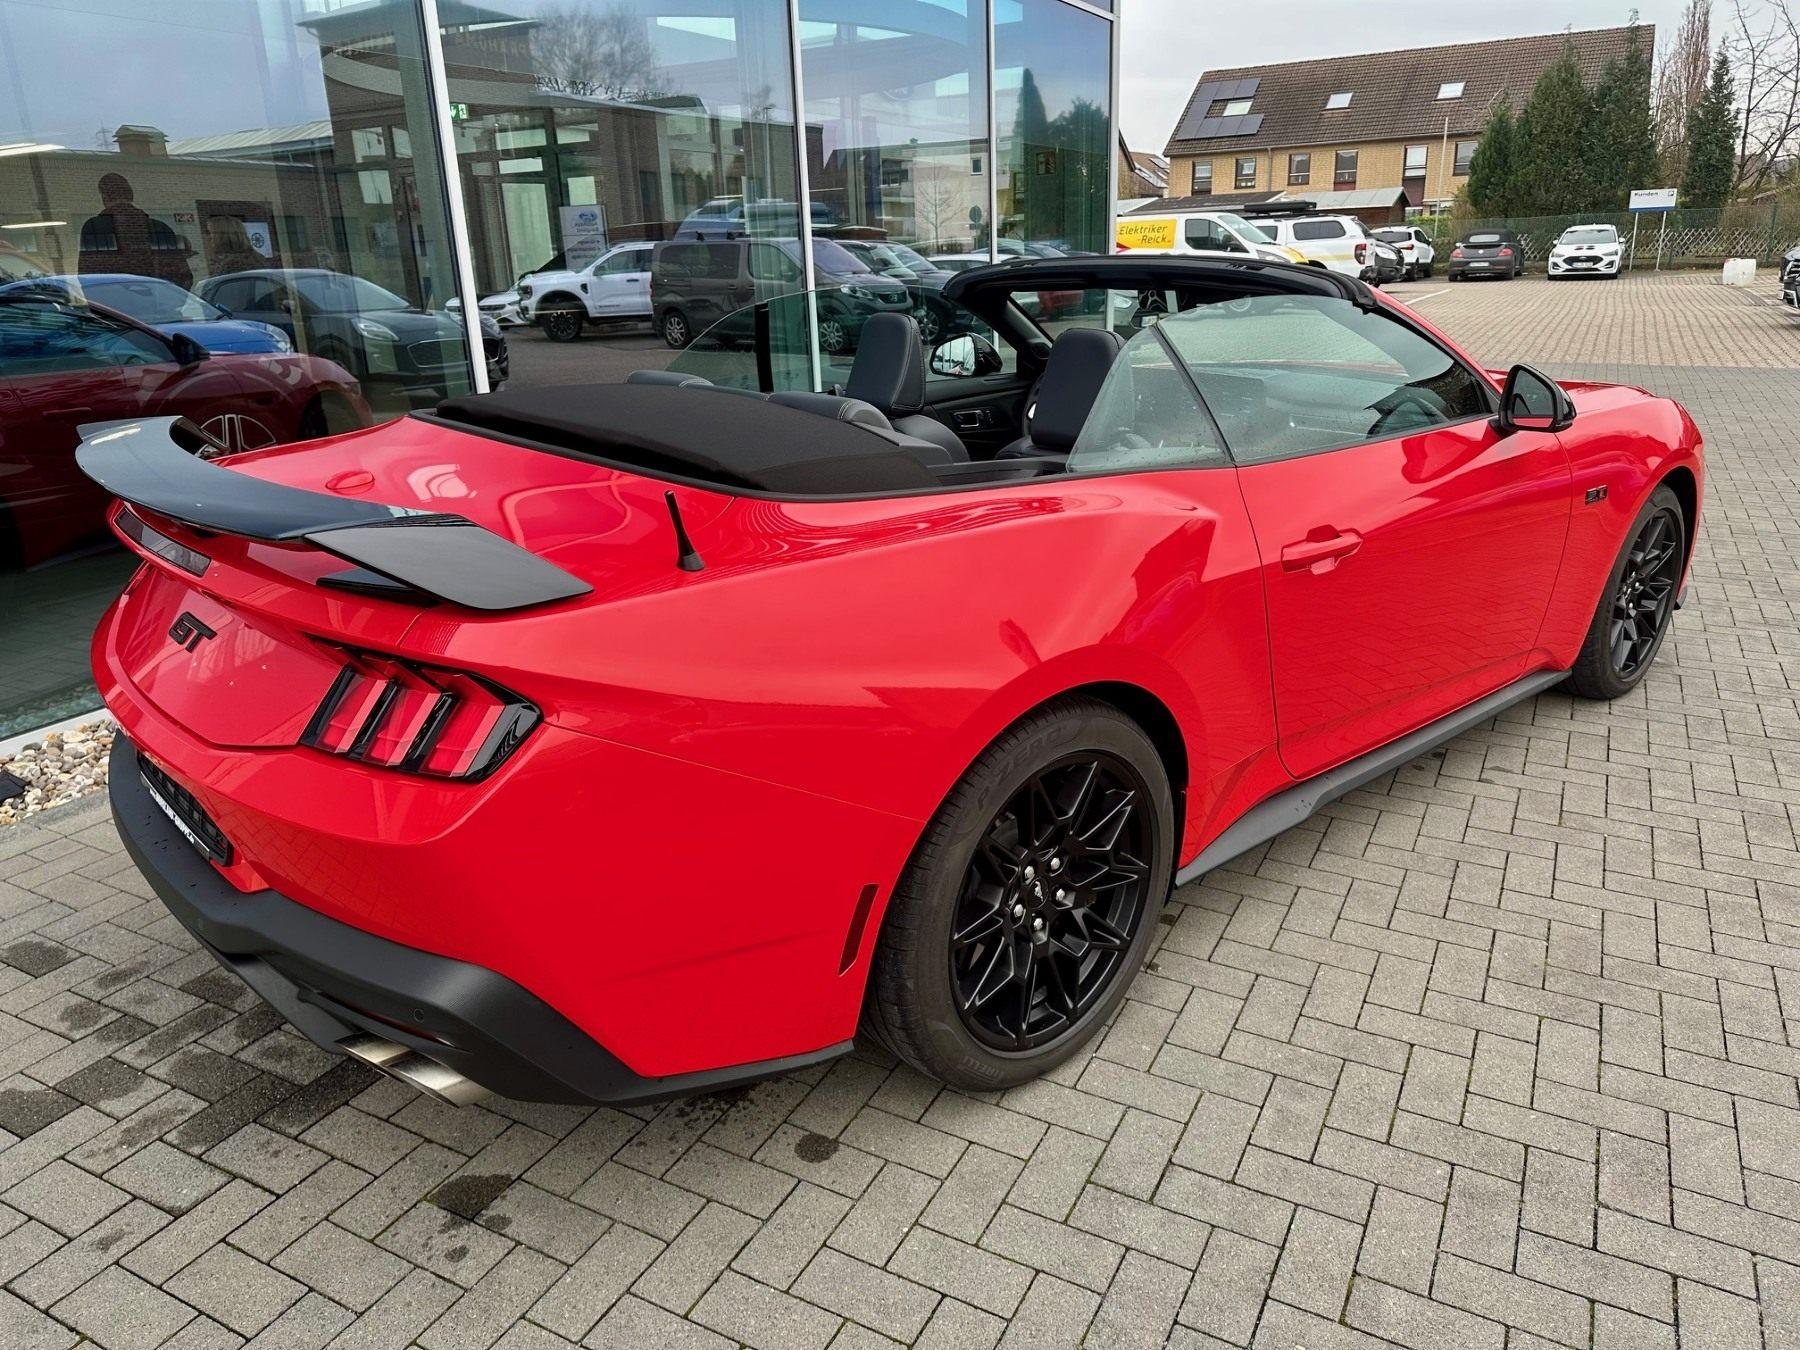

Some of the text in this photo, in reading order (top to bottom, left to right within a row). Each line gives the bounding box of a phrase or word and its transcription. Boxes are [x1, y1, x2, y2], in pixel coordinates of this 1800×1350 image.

[1119, 224, 1168, 235] Elektriker
[168, 611, 218, 653] GT
[997, 726, 1062, 786] ZERO
